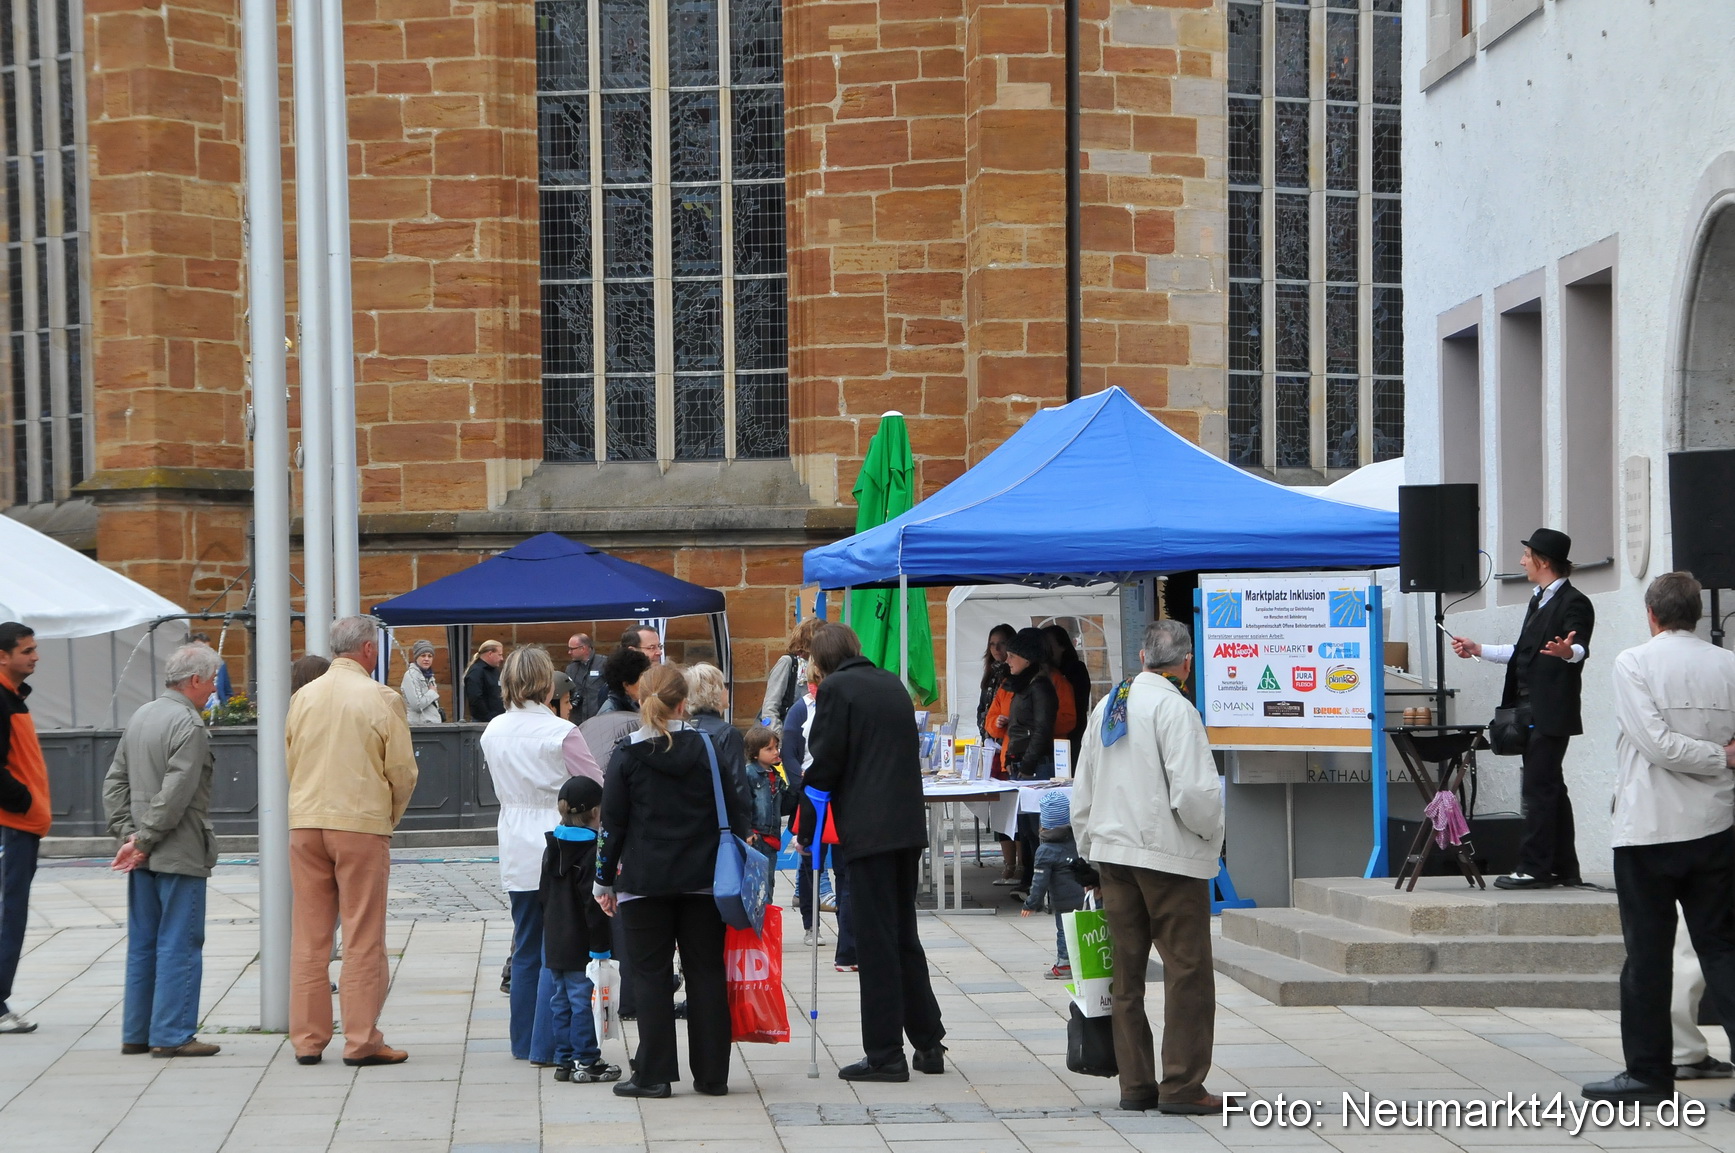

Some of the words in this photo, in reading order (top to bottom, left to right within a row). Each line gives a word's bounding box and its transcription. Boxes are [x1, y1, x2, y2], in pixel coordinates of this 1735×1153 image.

[1245, 590, 1287, 603] Marktplatz
[1289, 589, 1326, 601] Inklusion
[1264, 645, 1306, 653] NEUMARKT
[1224, 702, 1254, 711] MANN
[727, 948, 770, 982] KD
